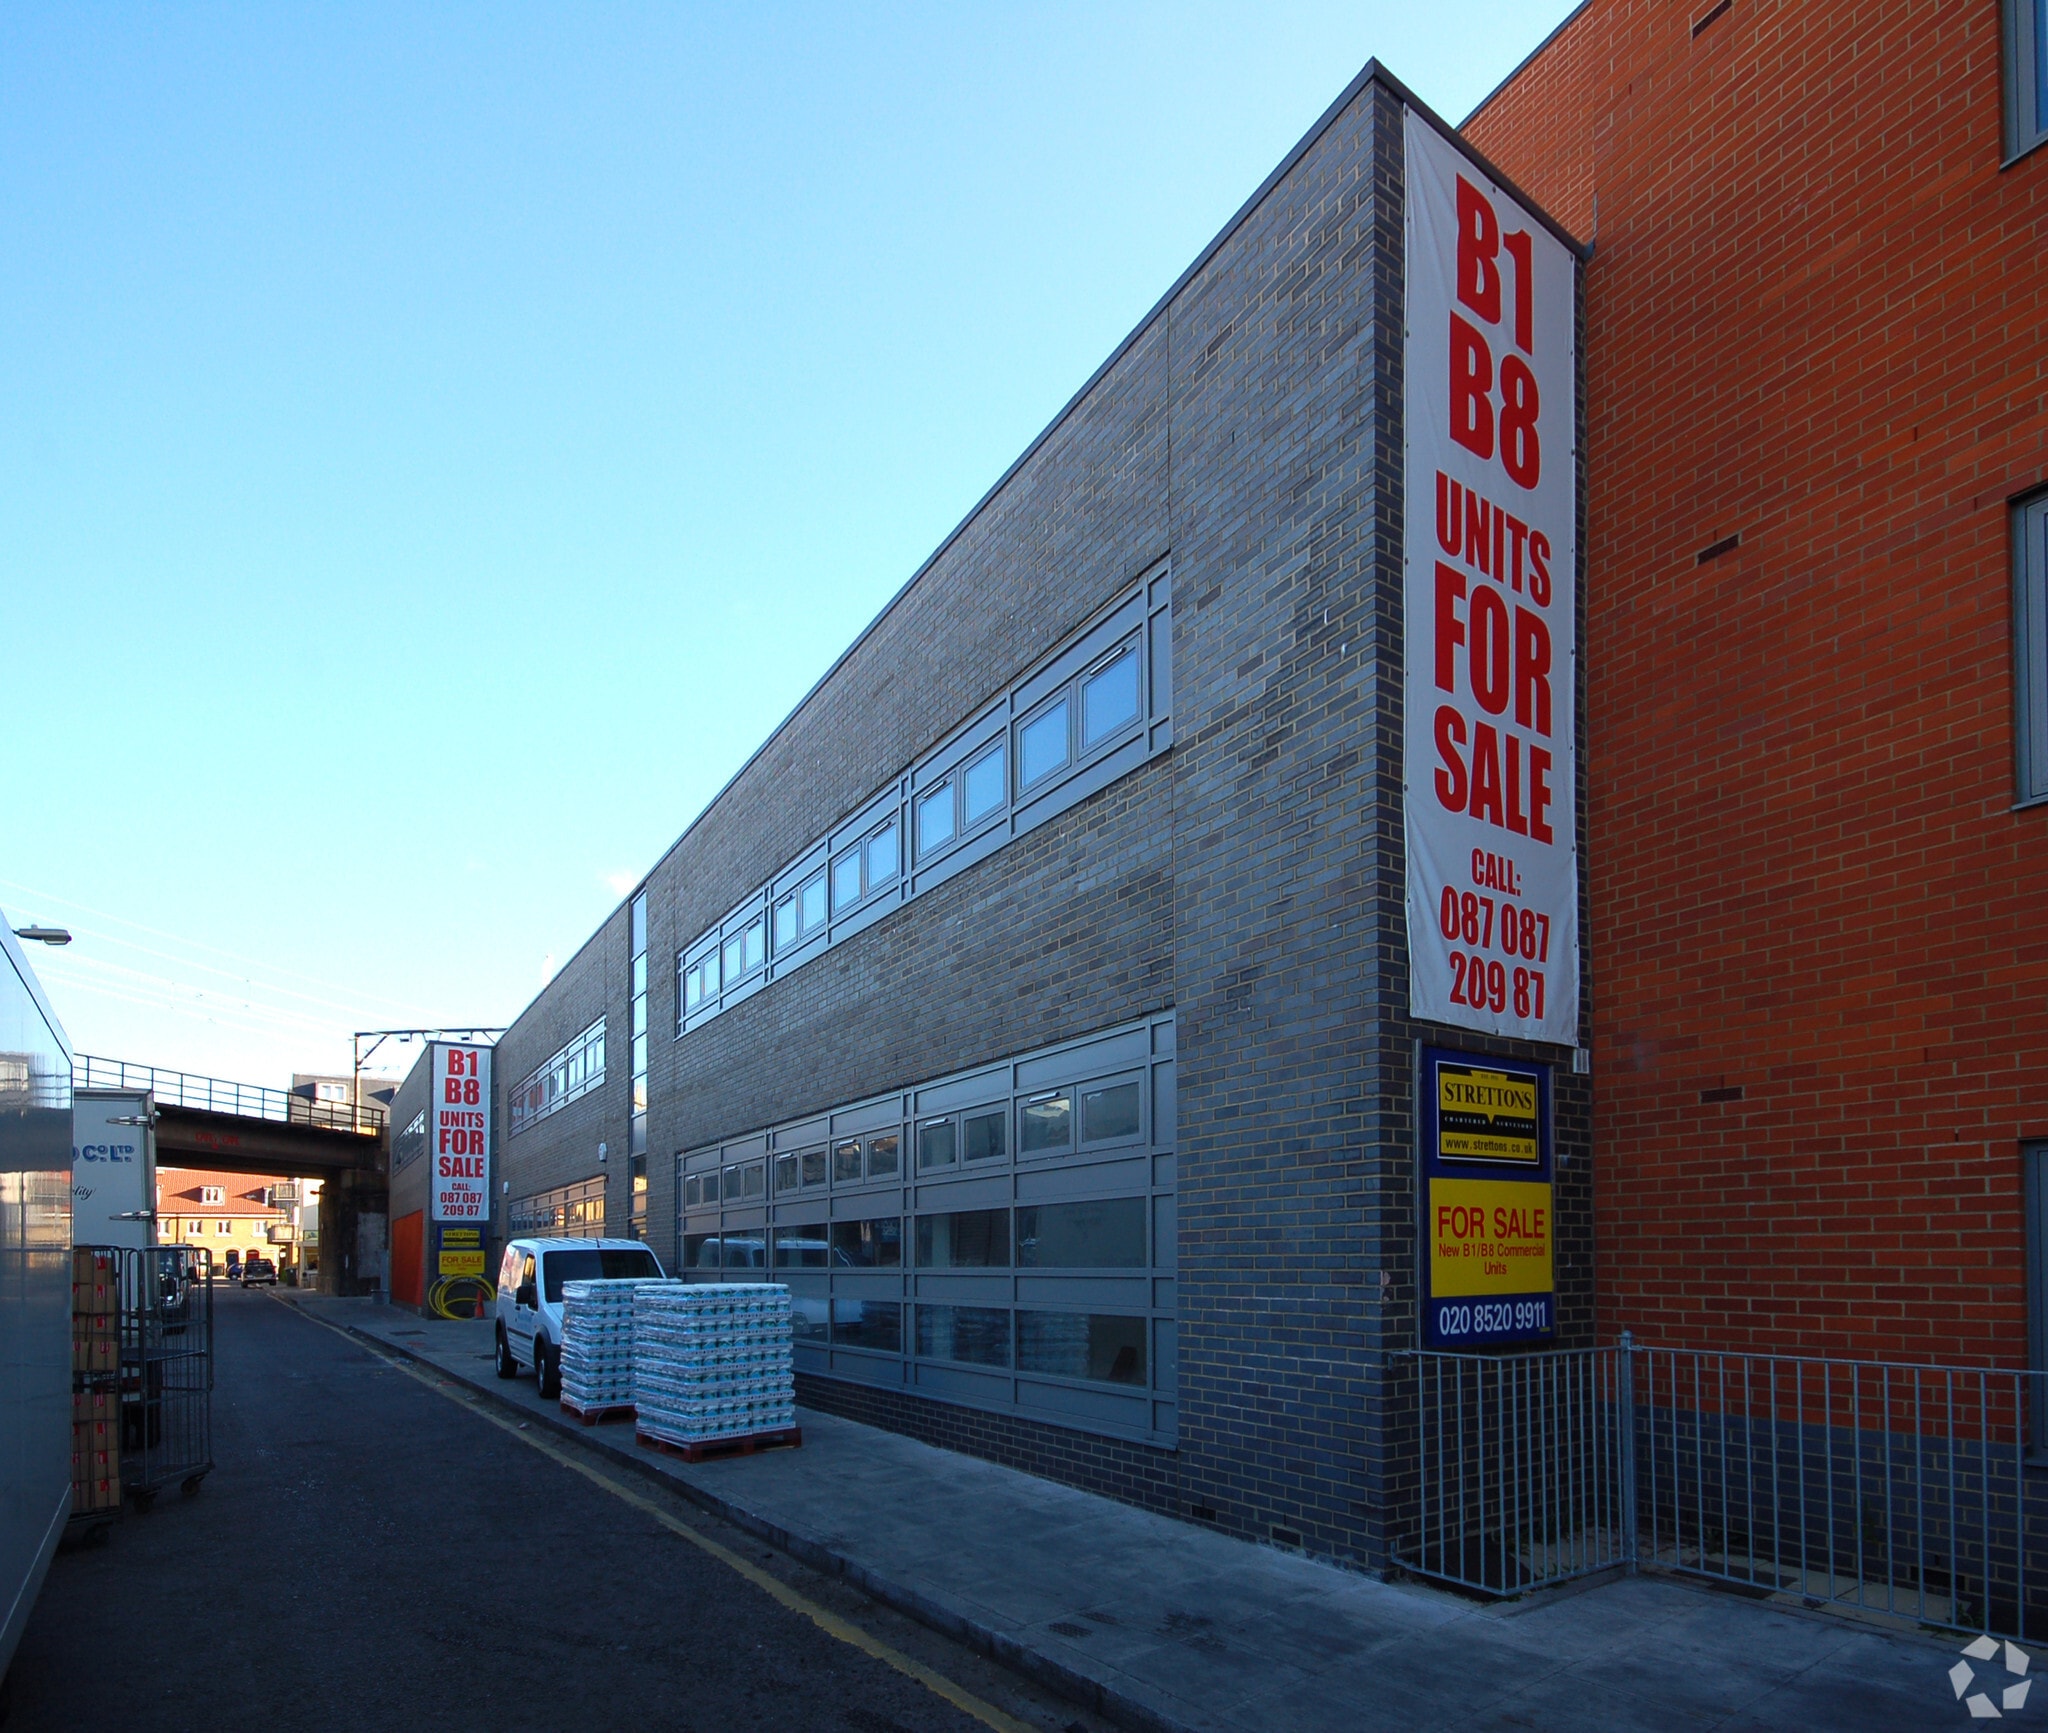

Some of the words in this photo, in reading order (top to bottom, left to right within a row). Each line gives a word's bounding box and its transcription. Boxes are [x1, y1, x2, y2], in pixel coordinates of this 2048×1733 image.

[1456, 171, 1533, 357] B1
[1449, 309, 1540, 491] B8
[1435, 469, 1552, 608] UNITS
[1434, 559, 1552, 738] FOR
[1433, 704, 1553, 845] SALE
[1471, 847, 1522, 897] CALL:
[1440, 885, 1494, 949] 087
[1501, 903, 1550, 963] 087
[1449, 950, 1506, 1014] 209
[1513, 966, 1544, 1020] 87
[448, 1049, 477, 1077] B1
[445, 1077, 480, 1106] B8
[1444, 1081, 1533, 1110] STRETTONS
[439, 1110, 485, 1128] UNITS
[439, 1128, 484, 1155] FOR
[1445, 1137, 1533, 1154] www.strettons.co.uk
[438, 1156, 484, 1178] SALE
[440, 1192, 461, 1204] 087
[462, 1192, 482, 1204] 087
[451, 1183, 471, 1191] CALL:
[443, 1204, 464, 1216] 209
[466, 1204, 479, 1216] 87
[1437, 1205, 1485, 1239] FOR
[1493, 1206, 1546, 1240] SALE
[441, 1255, 459, 1264] FOR
[461, 1255, 482, 1264] SALE
[1438, 1243, 1460, 1257] New
[1463, 1242, 1495, 1258] B1/B8
[1497, 1242, 1546, 1257] Commercial
[1484, 1261, 1508, 1275] Units
[1439, 1305, 1471, 1336] 020
[1474, 1303, 1513, 1333] 8520
[1515, 1301, 1546, 1330] 9911
